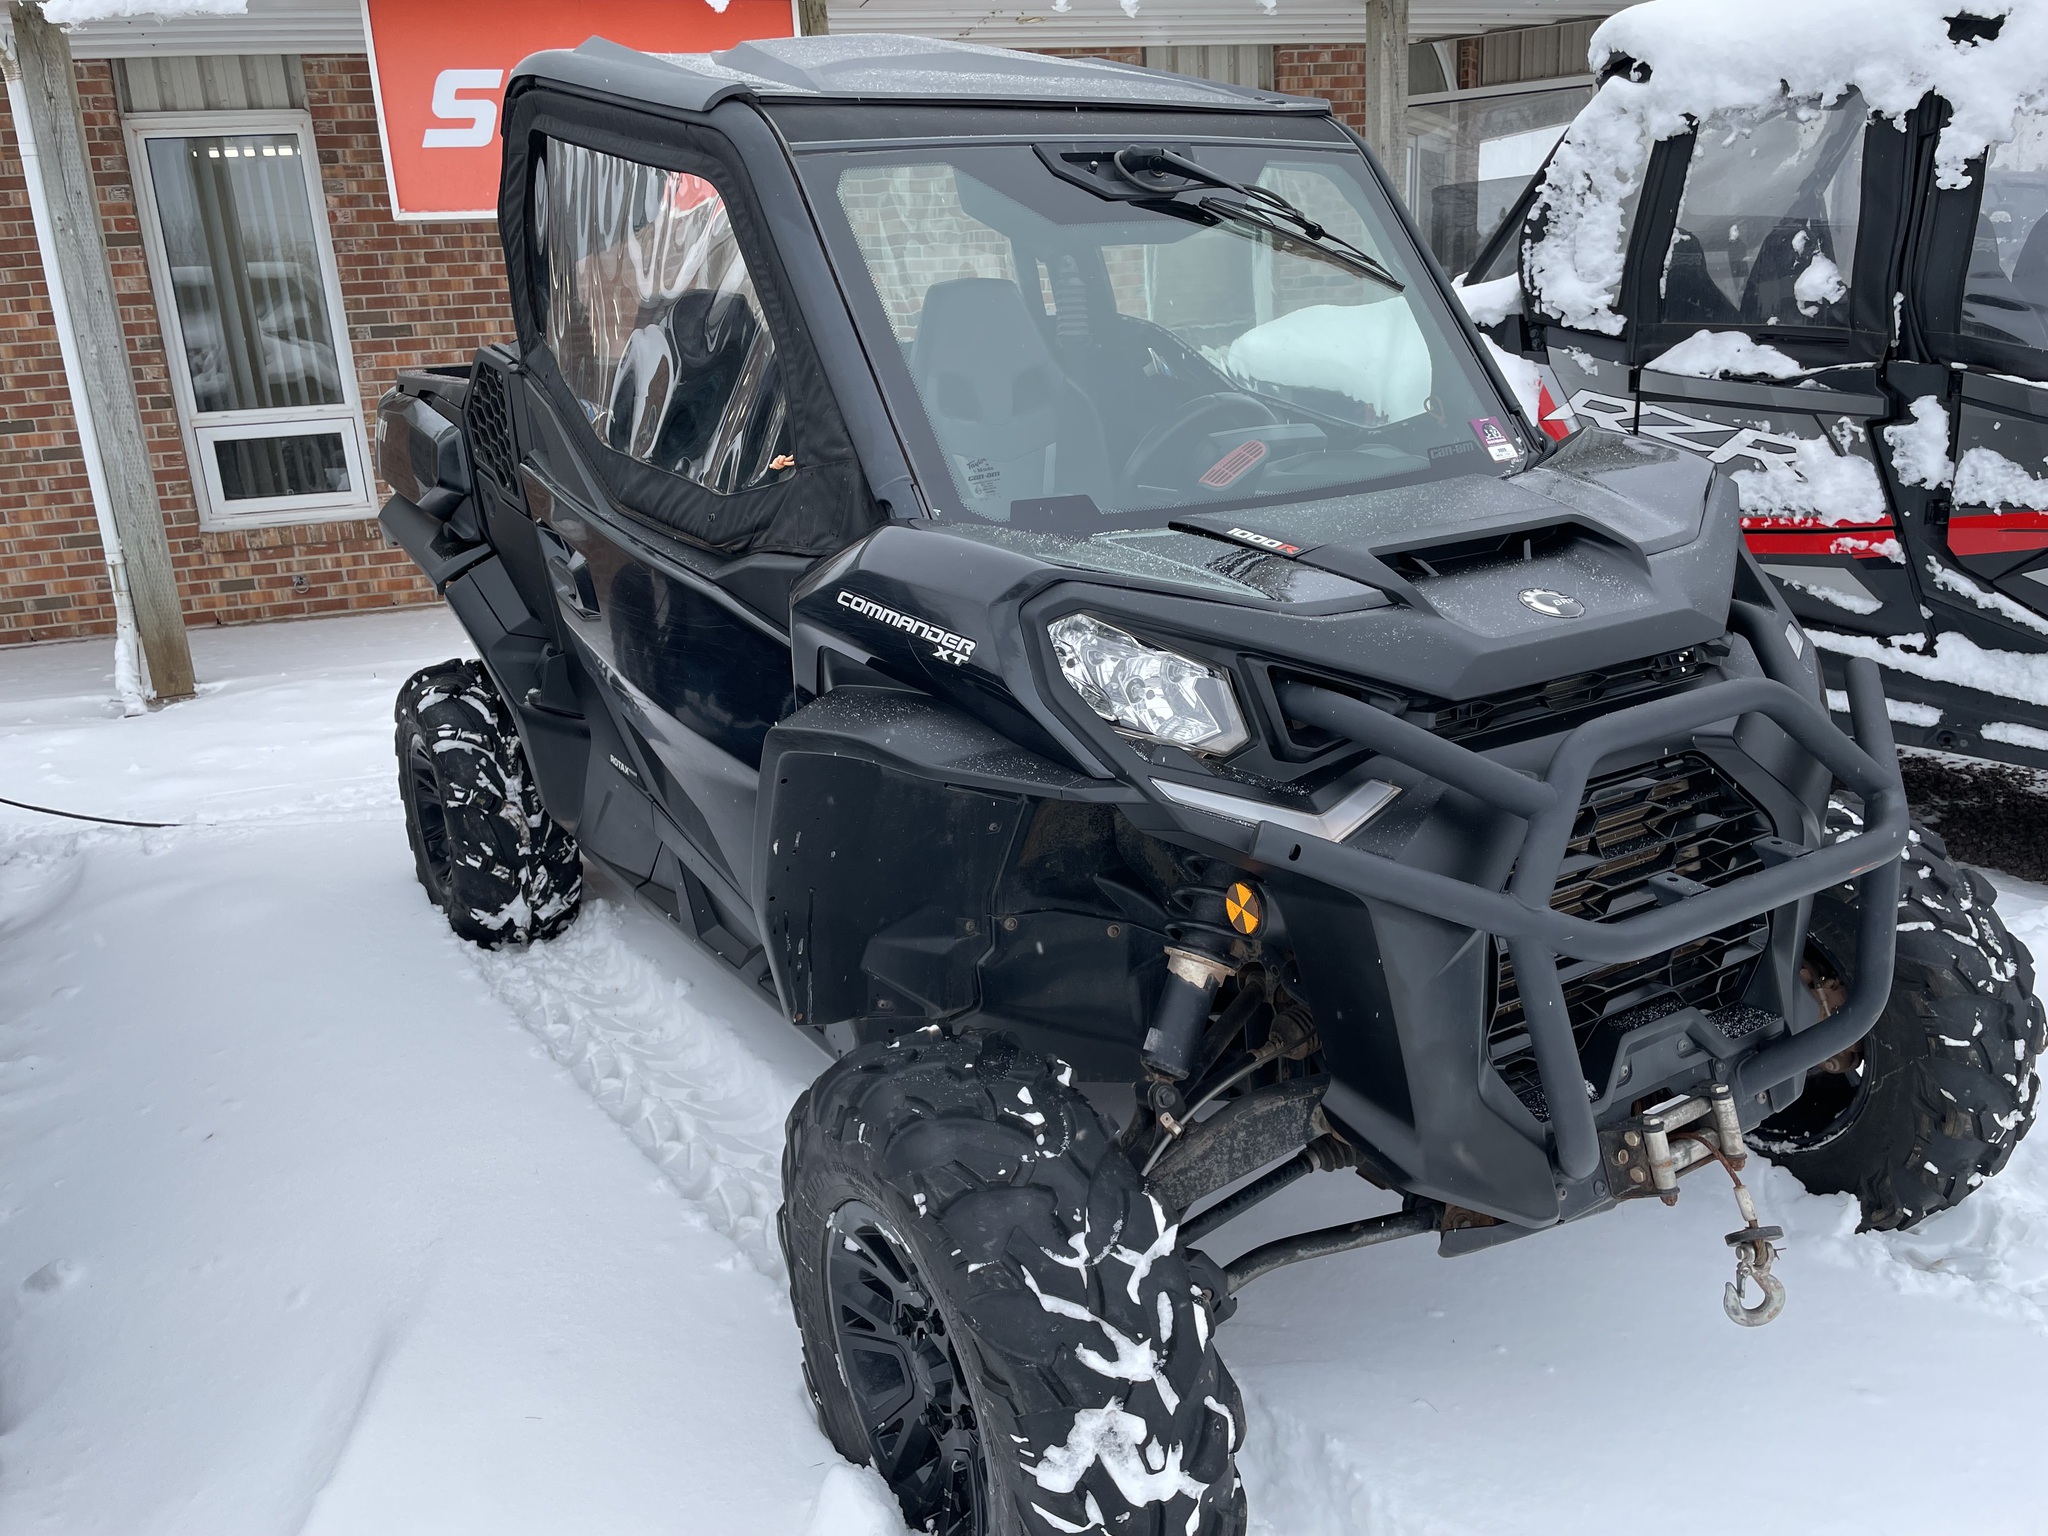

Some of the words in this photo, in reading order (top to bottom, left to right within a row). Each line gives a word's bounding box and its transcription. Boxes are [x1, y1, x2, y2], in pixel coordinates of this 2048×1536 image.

[422, 69, 514, 148] S
[1543, 388, 1808, 483] RZR
[1430, 442, 1475, 459] can-am
[1226, 527, 1300, 554] 1000R
[1552, 598, 1575, 606] BRP
[837, 591, 976, 655] COMMANDER
[932, 646, 969, 665] XT
[609, 753, 630, 776] ROTAX
